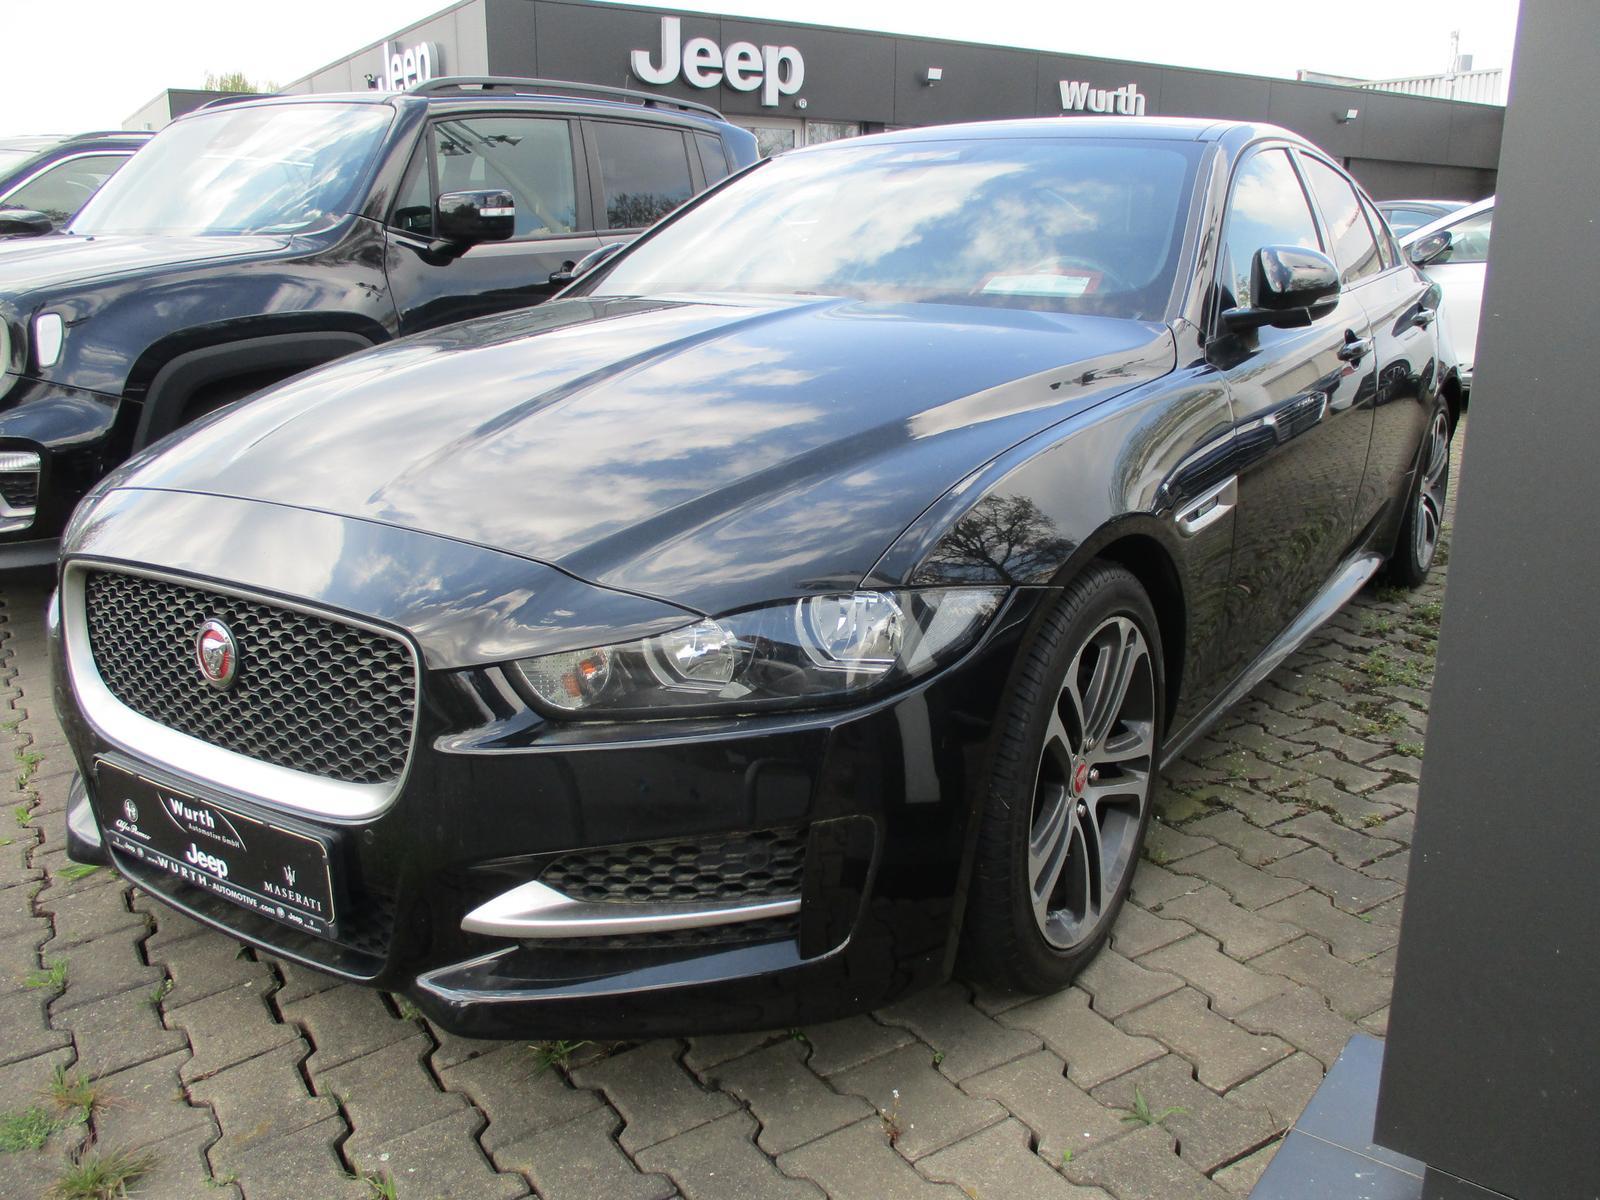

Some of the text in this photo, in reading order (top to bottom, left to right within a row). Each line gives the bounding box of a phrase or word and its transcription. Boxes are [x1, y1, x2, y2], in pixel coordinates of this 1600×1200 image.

[377, 40, 434, 91] Jeep
[630, 16, 805, 107] Jeep
[1059, 80, 1146, 116] Wurth
[169, 798, 216, 829] Wurth
[188, 822, 240, 848] Automotive GmbH
[186, 842, 229, 878] Jeep
[263, 881, 322, 912] MASERATI
